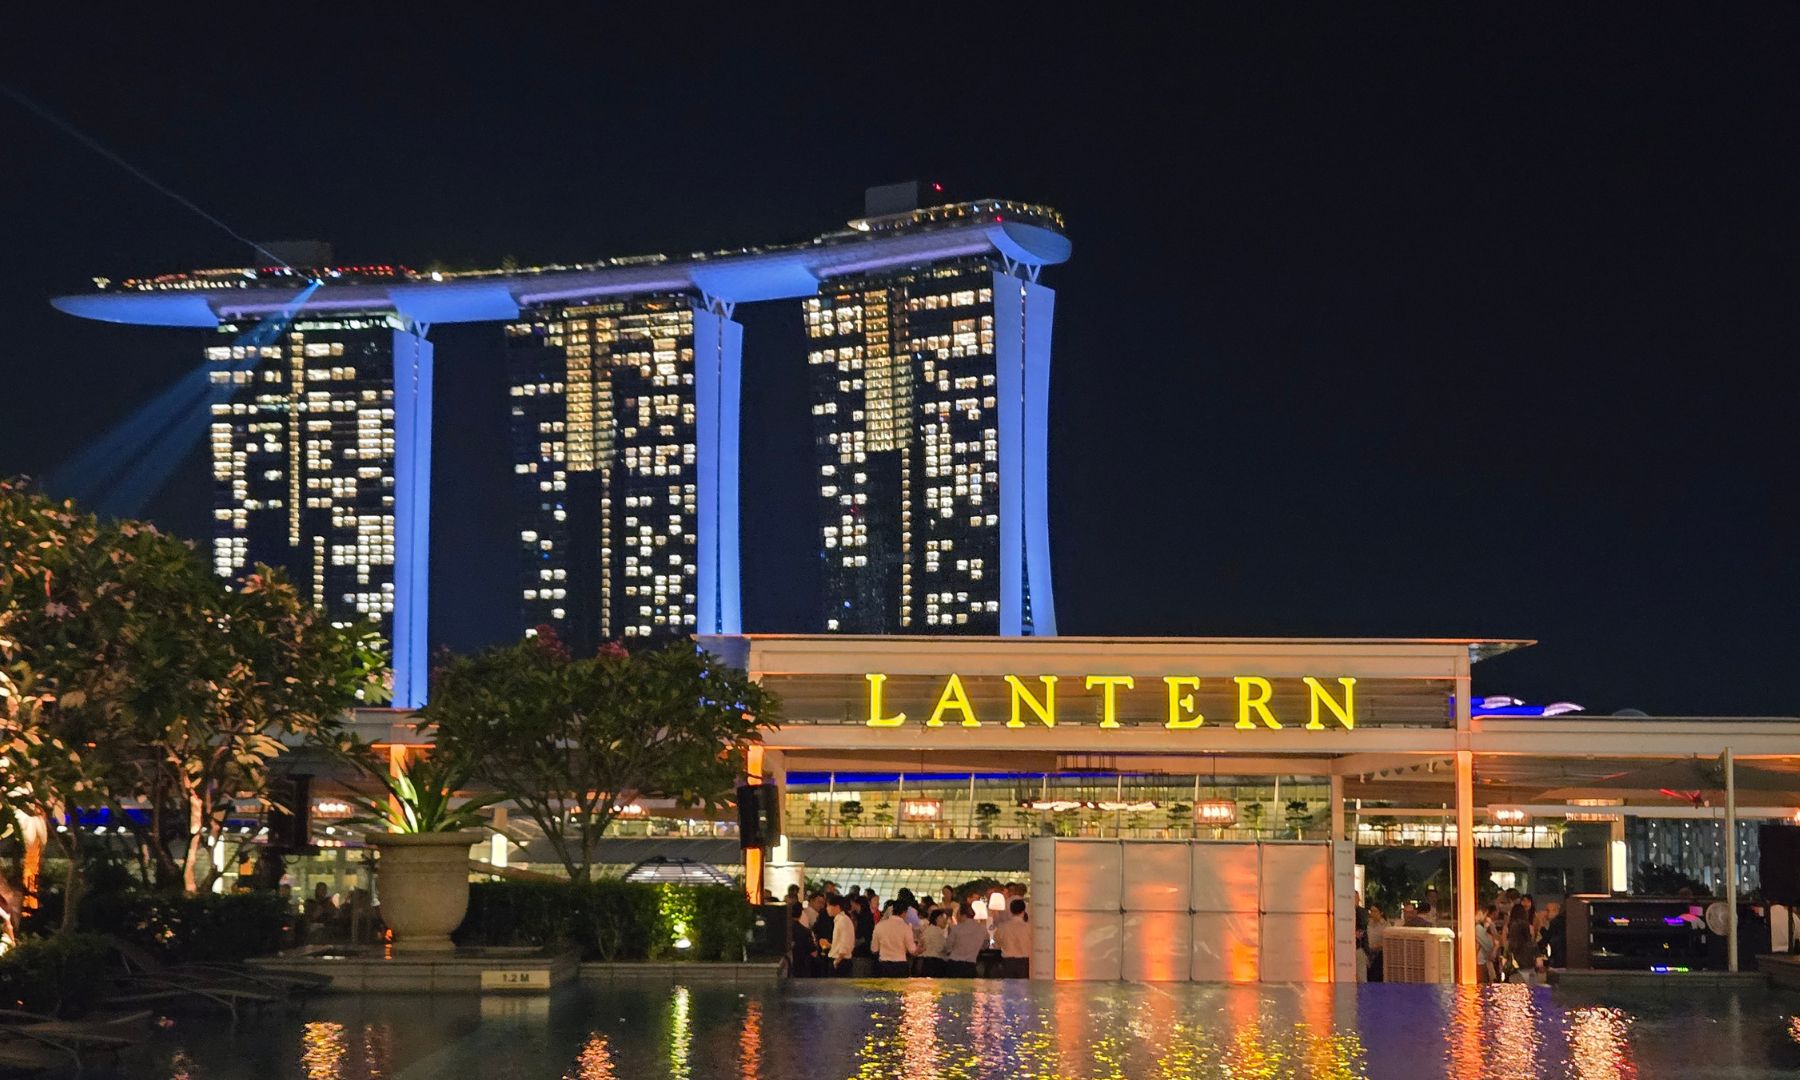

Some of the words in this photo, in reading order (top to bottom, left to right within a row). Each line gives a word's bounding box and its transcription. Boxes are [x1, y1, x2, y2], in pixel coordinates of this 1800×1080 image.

[864, 672, 1358, 731] LANTERN
[502, 973, 518, 983] 1.2
[520, 973, 530, 983] M
